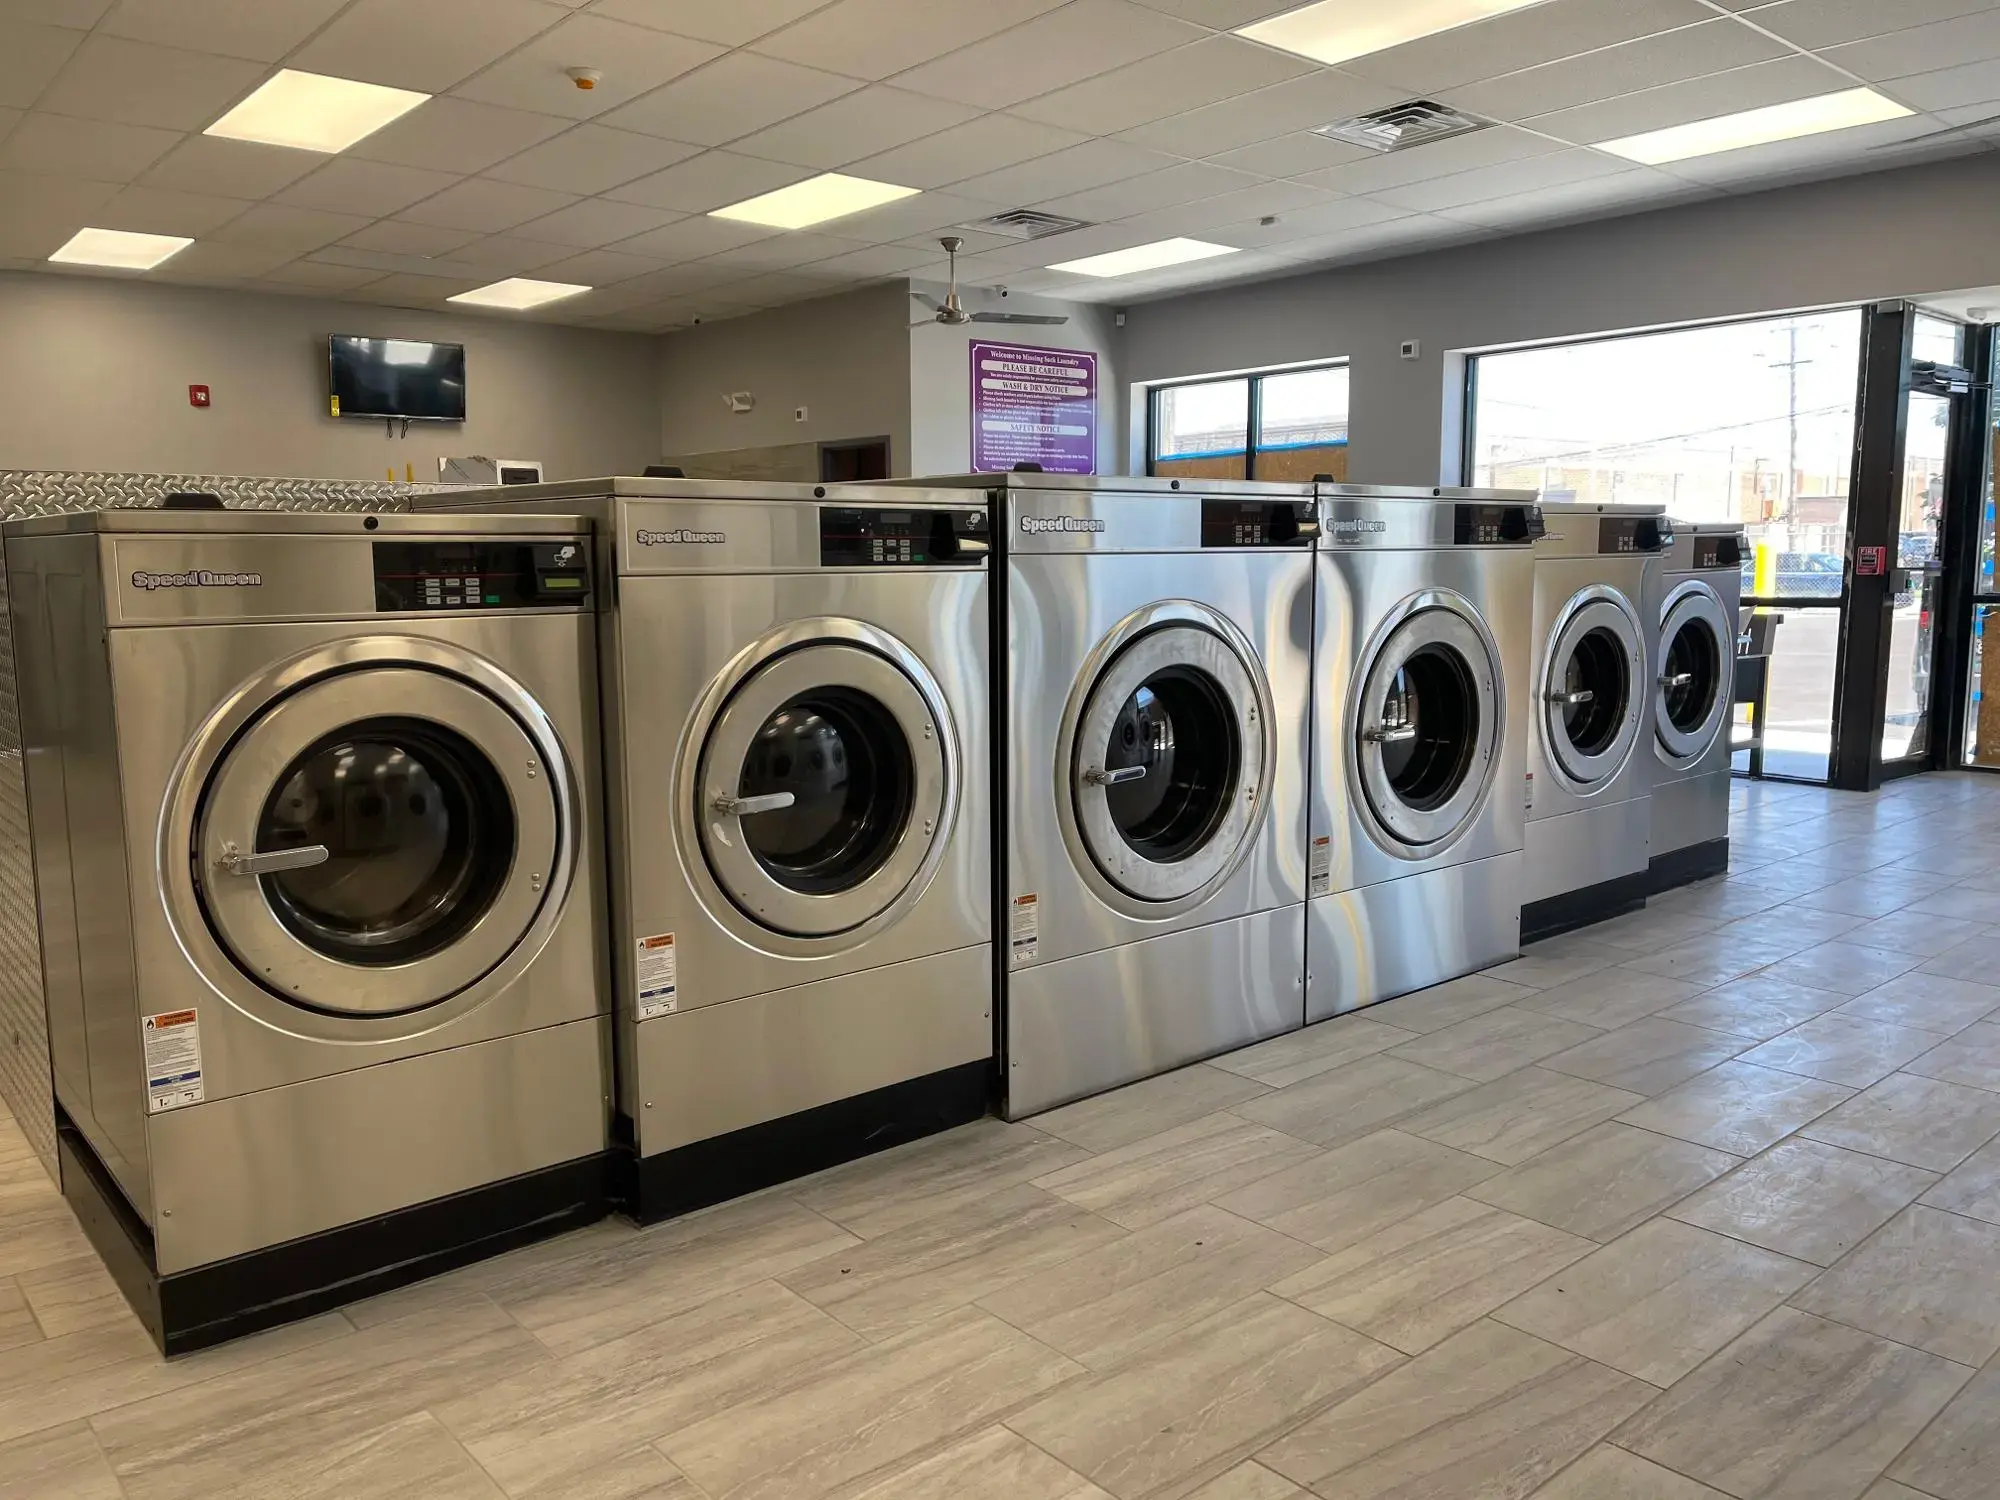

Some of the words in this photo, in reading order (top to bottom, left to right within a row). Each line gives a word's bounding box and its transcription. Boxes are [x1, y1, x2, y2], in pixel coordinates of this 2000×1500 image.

[990, 350, 1015, 360] Welcome
[1022, 354, 1044, 364] Missing
[1057, 357, 1079, 367] Laundry
[1002, 363, 1028, 373] PLEASE
[1029, 365, 1037, 373] BE
[1038, 366, 1069, 377] CAREFUL
[1002, 381, 1023, 391] WASH
[1023, 383, 1029, 391] &
[1029, 383, 1044, 393] DRY
[1044, 384, 1069, 394] NOTICE
[1010, 423, 1035, 432] SAFETY
[1036, 425, 1060, 433] NOTICE
